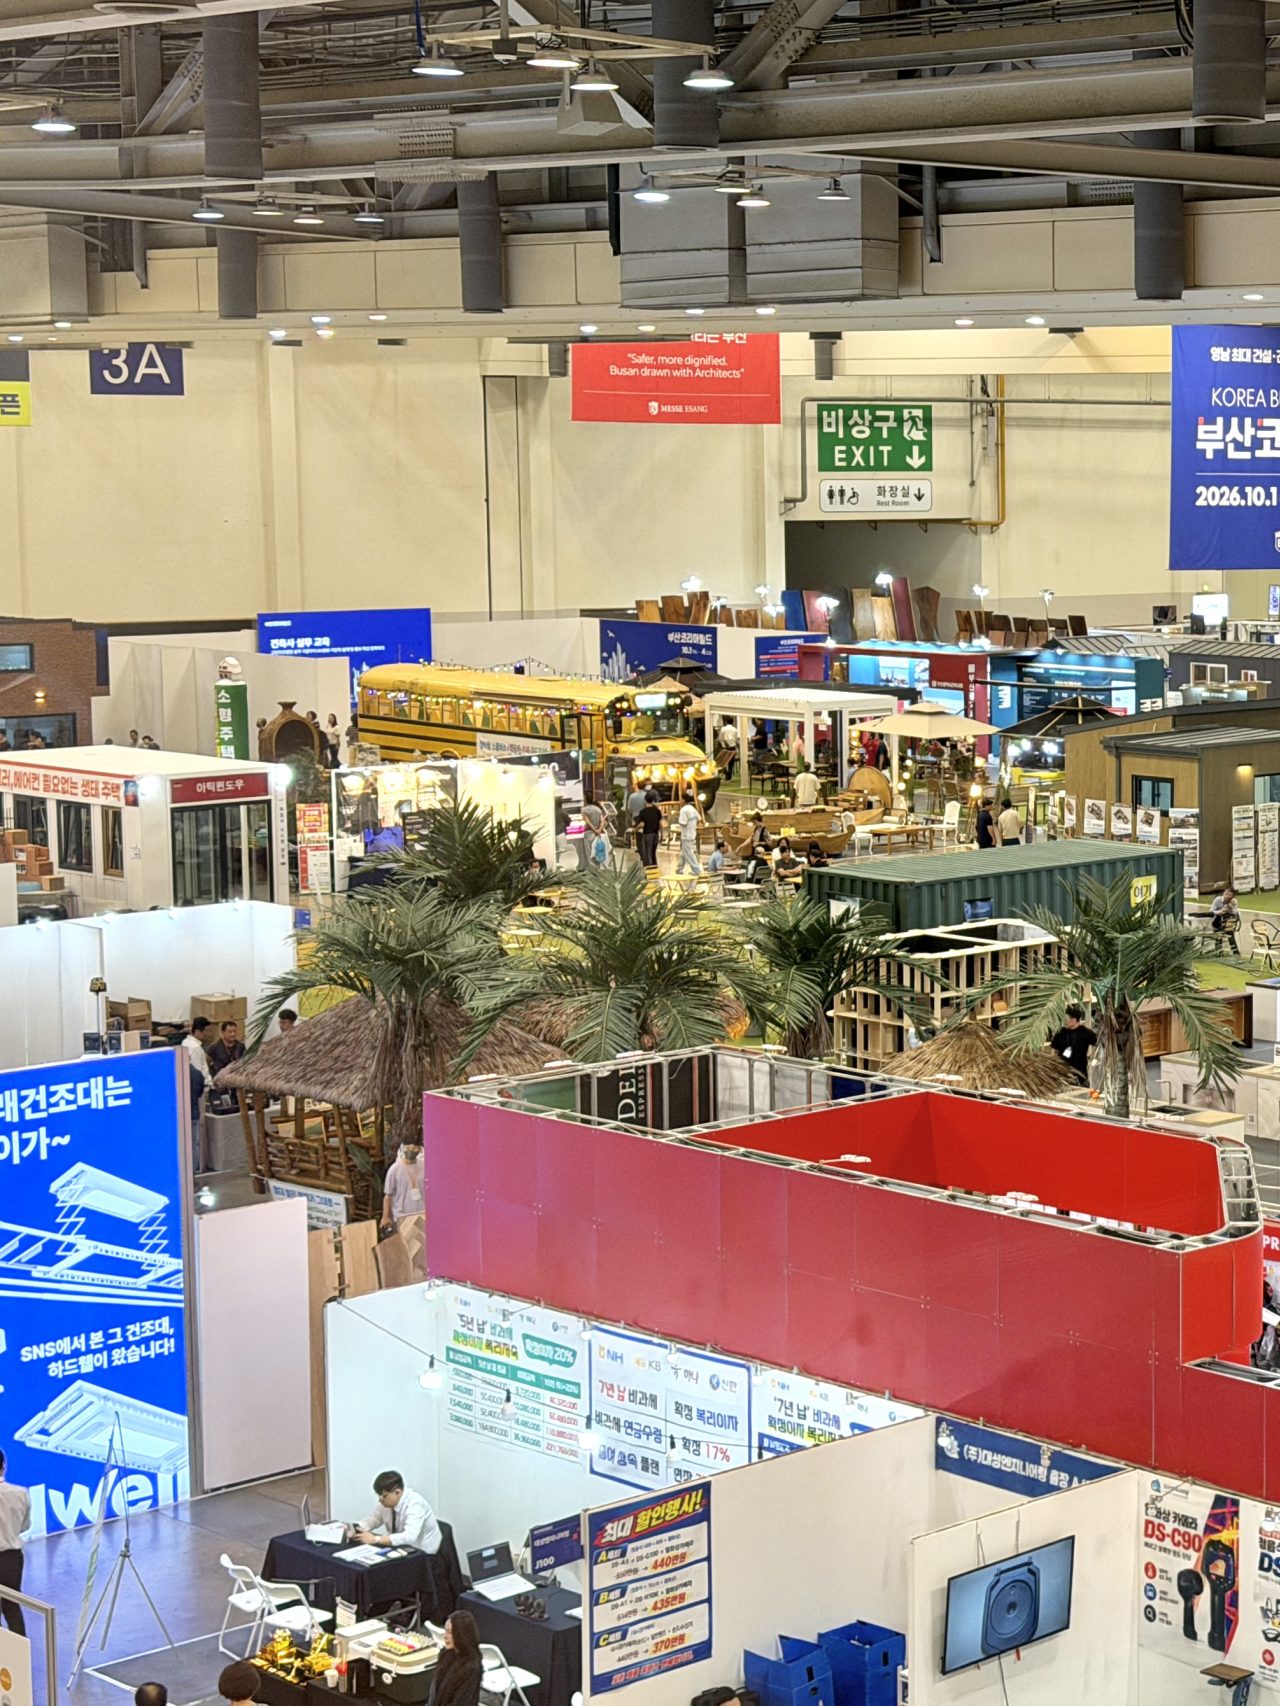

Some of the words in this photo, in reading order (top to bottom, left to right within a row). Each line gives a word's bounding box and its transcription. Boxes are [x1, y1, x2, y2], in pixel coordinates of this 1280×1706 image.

[102, 344, 171, 385] 3A
[658, 357, 683, 365] more
[684, 355, 728, 367] dignified.
[1210, 347, 1231, 363] 영남
[1231, 348, 1252, 364] 최대
[609, 365, 640, 376] Busan
[641, 367, 670, 377] drawn
[672, 367, 693, 377] with
[661, 405, 684, 413] MESSE
[685, 405, 708, 413] ESANG
[1211, 387, 1267, 409] KOREA
[822, 409, 899, 439] 비상구
[834, 445, 892, 468] EXIT
[875, 485, 911, 499] 화장실
[876, 499, 892, 507] Rest
[893, 499, 910, 508] Room
[42, 773, 79, 797] 필요없는
[101, 781, 121, 801] 주택
[20, 1334, 86, 1362] SNS에서
[88, 1330, 105, 1349] 본
[107, 1327, 124, 1345] 그
[126, 1316, 175, 1340] 건조대,
[47, 1354, 108, 1379] 하드웰이
[111, 1337, 175, 1368] 왔습니다!
[606, 1348, 624, 1365] NH
[648, 1359, 662, 1372] KB
[683, 1369, 699, 1385] 하나
[628, 1389, 658, 1411] 비과세
[674, 1400, 693, 1422] 확정
[695, 1407, 739, 1433] 복리이자
[623, 1419, 663, 1445] 연금수령
[681, 1435, 702, 1457] 확정
[705, 1442, 731, 1463] 17%
[640, 1455, 660, 1476] 플랜
[601, 1515, 634, 1544] 최대
[635, 1488, 703, 1533] 할인행사!
[1143, 1518, 1203, 1554] DS-C90
[651, 1551, 687, 1571] 440만원
[651, 1592, 686, 1612] 435만원
[652, 1633, 686, 1654] 370만원
